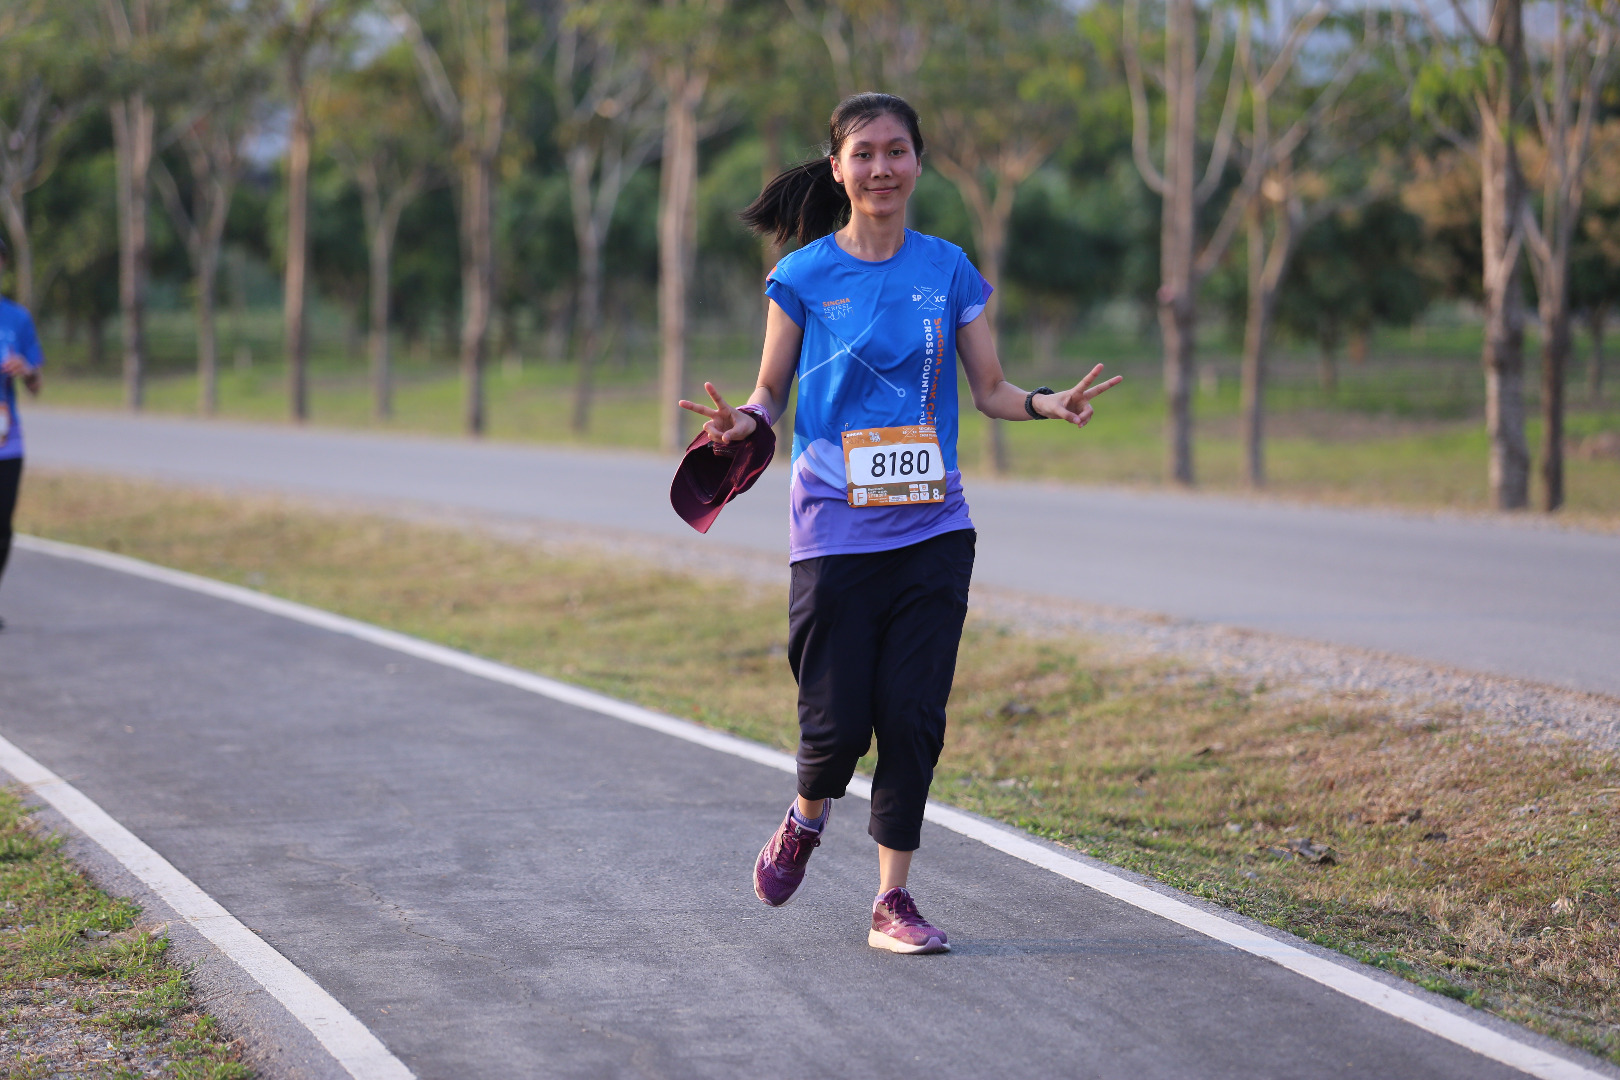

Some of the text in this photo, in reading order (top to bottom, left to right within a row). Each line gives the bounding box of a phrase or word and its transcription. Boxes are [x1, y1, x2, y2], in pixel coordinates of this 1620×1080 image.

[822, 297, 851, 307] SINGHA
[911, 294, 922, 302] SP
[923, 318, 934, 355] CROSS
[934, 318, 944, 366] SINGHA
[871, 449, 930, 477] 8180
[857, 492, 864, 503] F
[932, 488, 940, 500] 8
